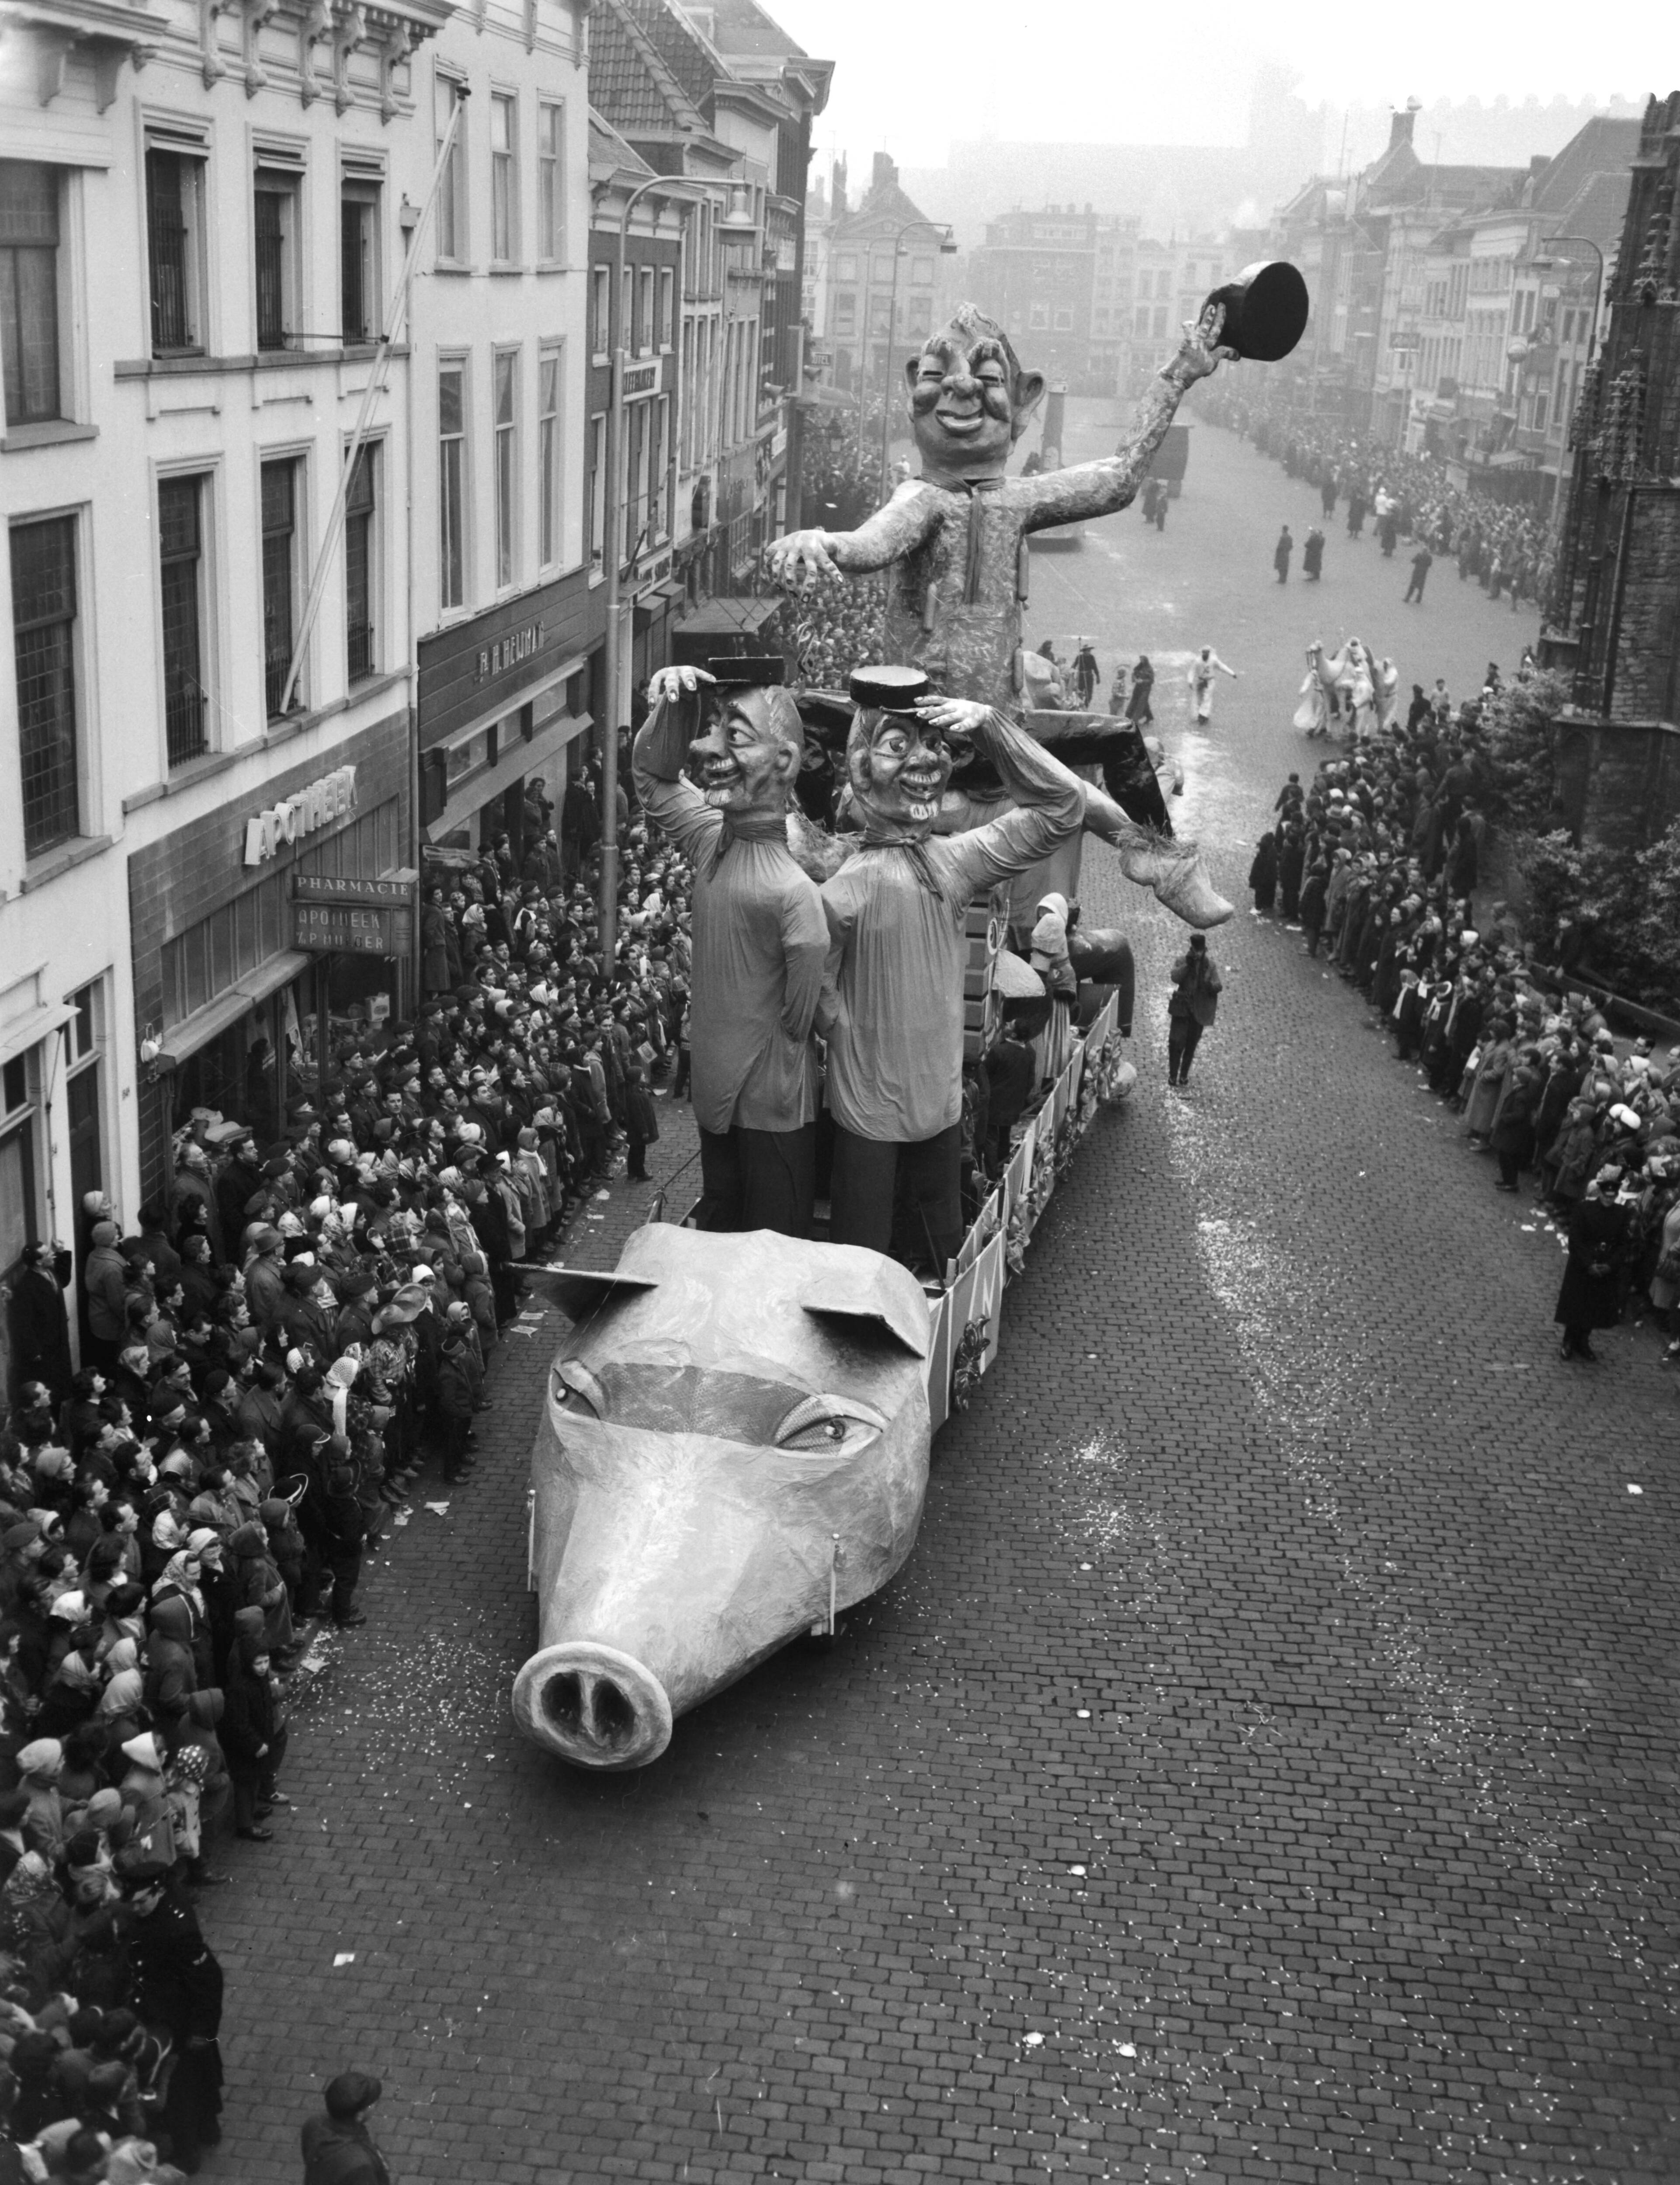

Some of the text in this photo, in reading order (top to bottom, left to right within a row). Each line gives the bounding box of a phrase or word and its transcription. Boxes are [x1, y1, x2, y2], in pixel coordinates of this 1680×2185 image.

[245, 765, 358, 865] APOTHEEK
[298, 877, 408, 895] PHARMACIE
[299, 909, 380, 929] APOTHEEK
[323, 934, 383, 949] MULDER
